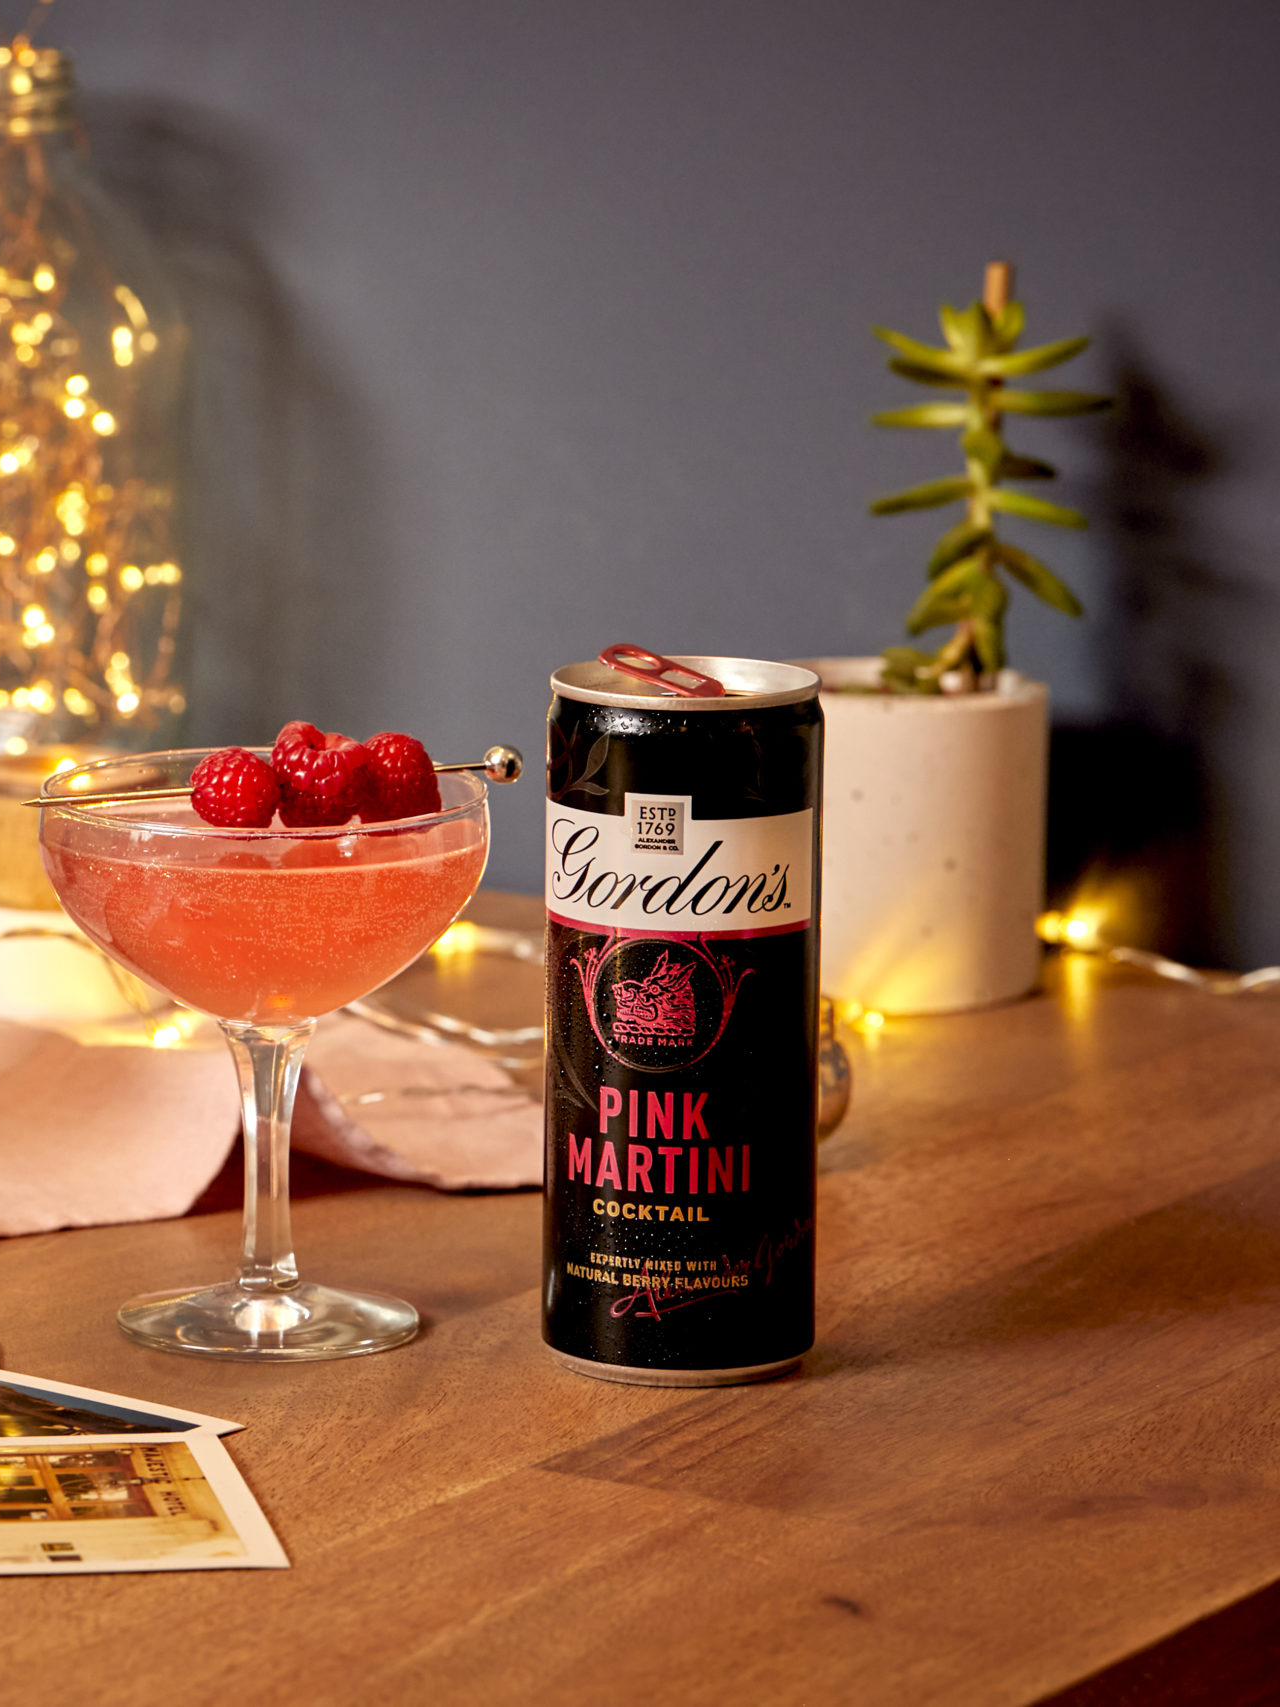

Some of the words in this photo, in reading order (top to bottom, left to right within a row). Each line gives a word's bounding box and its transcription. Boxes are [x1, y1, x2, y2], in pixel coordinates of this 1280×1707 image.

[636, 821, 675, 836] 1769
[551, 818, 790, 916] Gordon's
[613, 1033, 653, 1046] TRADE
[657, 1037, 694, 1047] MARK
[599, 1085, 710, 1140] PINK
[568, 1132, 750, 1195] MARTINI
[592, 1198, 710, 1222] COCKTAIL
[590, 1251, 640, 1269] EXPERTLY
[646, 1259, 682, 1272] MIXED
[686, 1260, 717, 1272] WITH
[566, 1261, 619, 1285] NATURAL
[622, 1273, 670, 1289] BERRY
[674, 1274, 749, 1290] FLAVOURS
